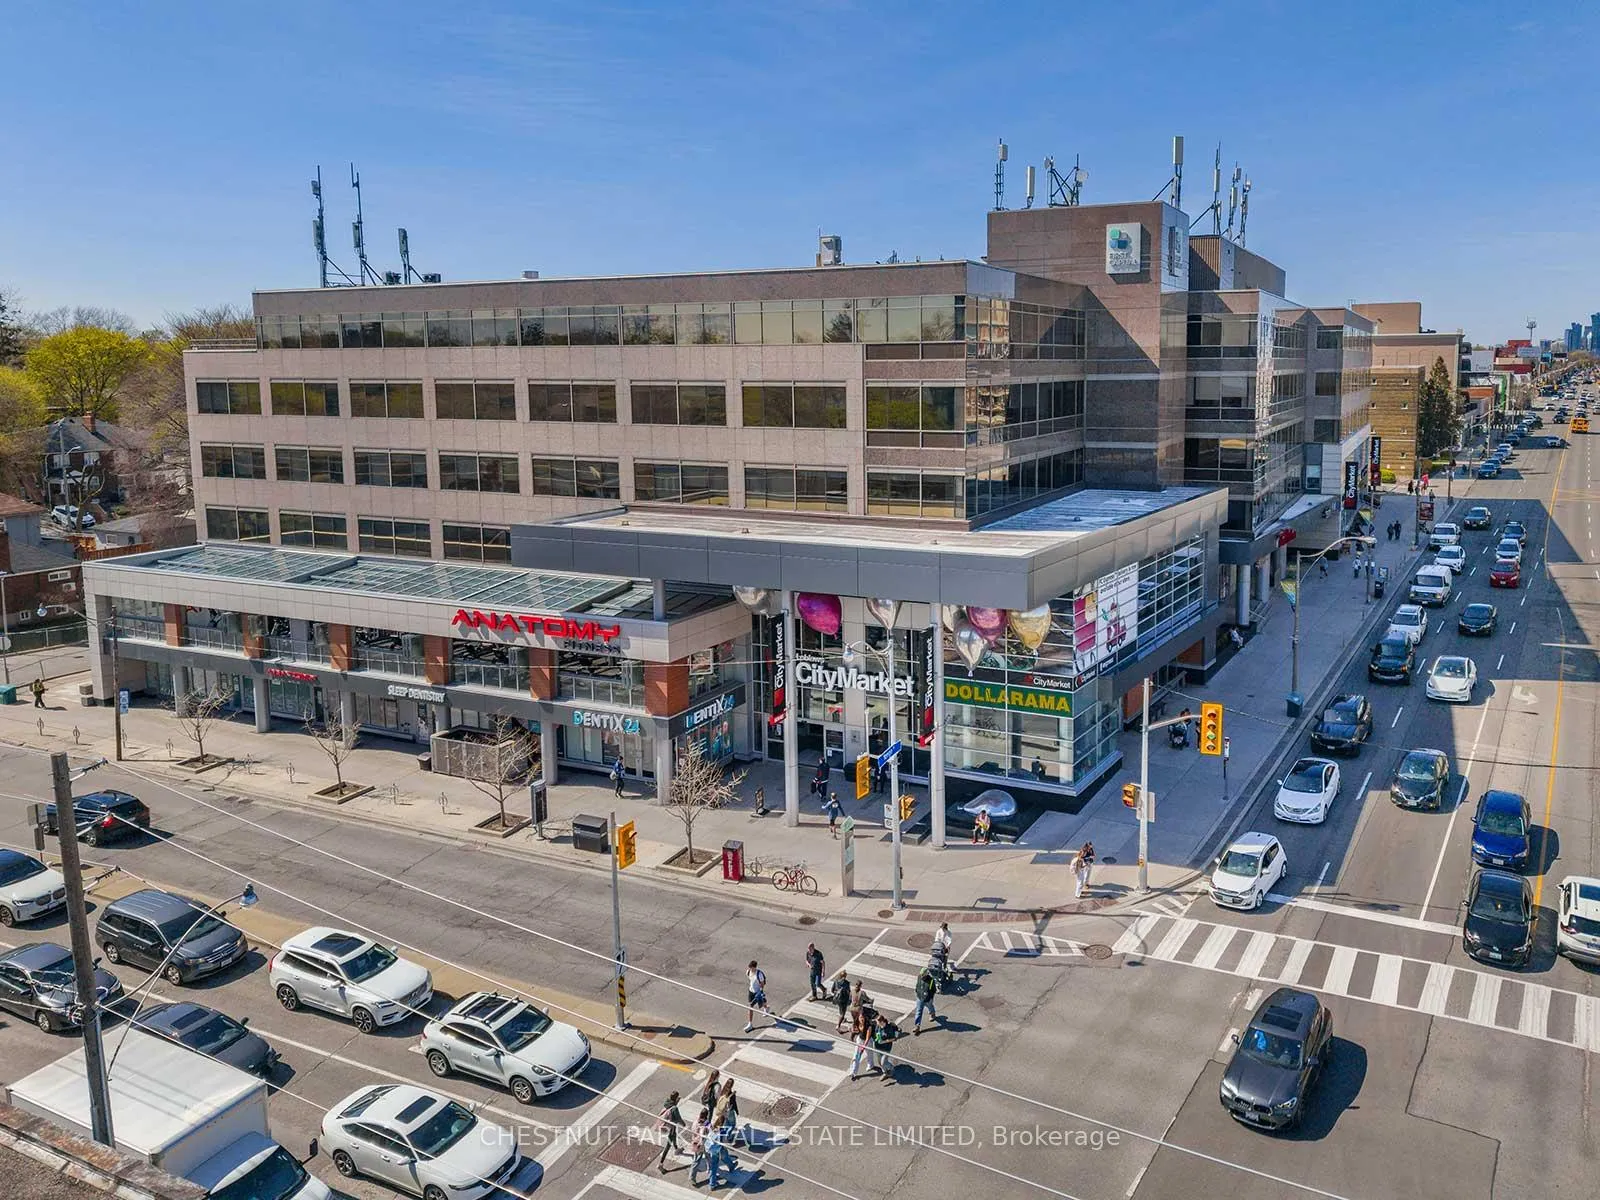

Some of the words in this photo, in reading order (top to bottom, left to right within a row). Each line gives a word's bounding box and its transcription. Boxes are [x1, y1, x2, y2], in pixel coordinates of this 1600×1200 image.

[452, 608, 621, 643] ANATOMY
[775, 622, 785, 689] CityMarket
[926, 637, 935, 707] CityMarket
[387, 685, 408, 697] SLEEP
[408, 687, 446, 703] DENTISTRY
[795, 661, 915, 697] CityMarket
[1032, 676, 1072, 690] CityMarket
[945, 683, 1071, 713] DOLLARAMA
